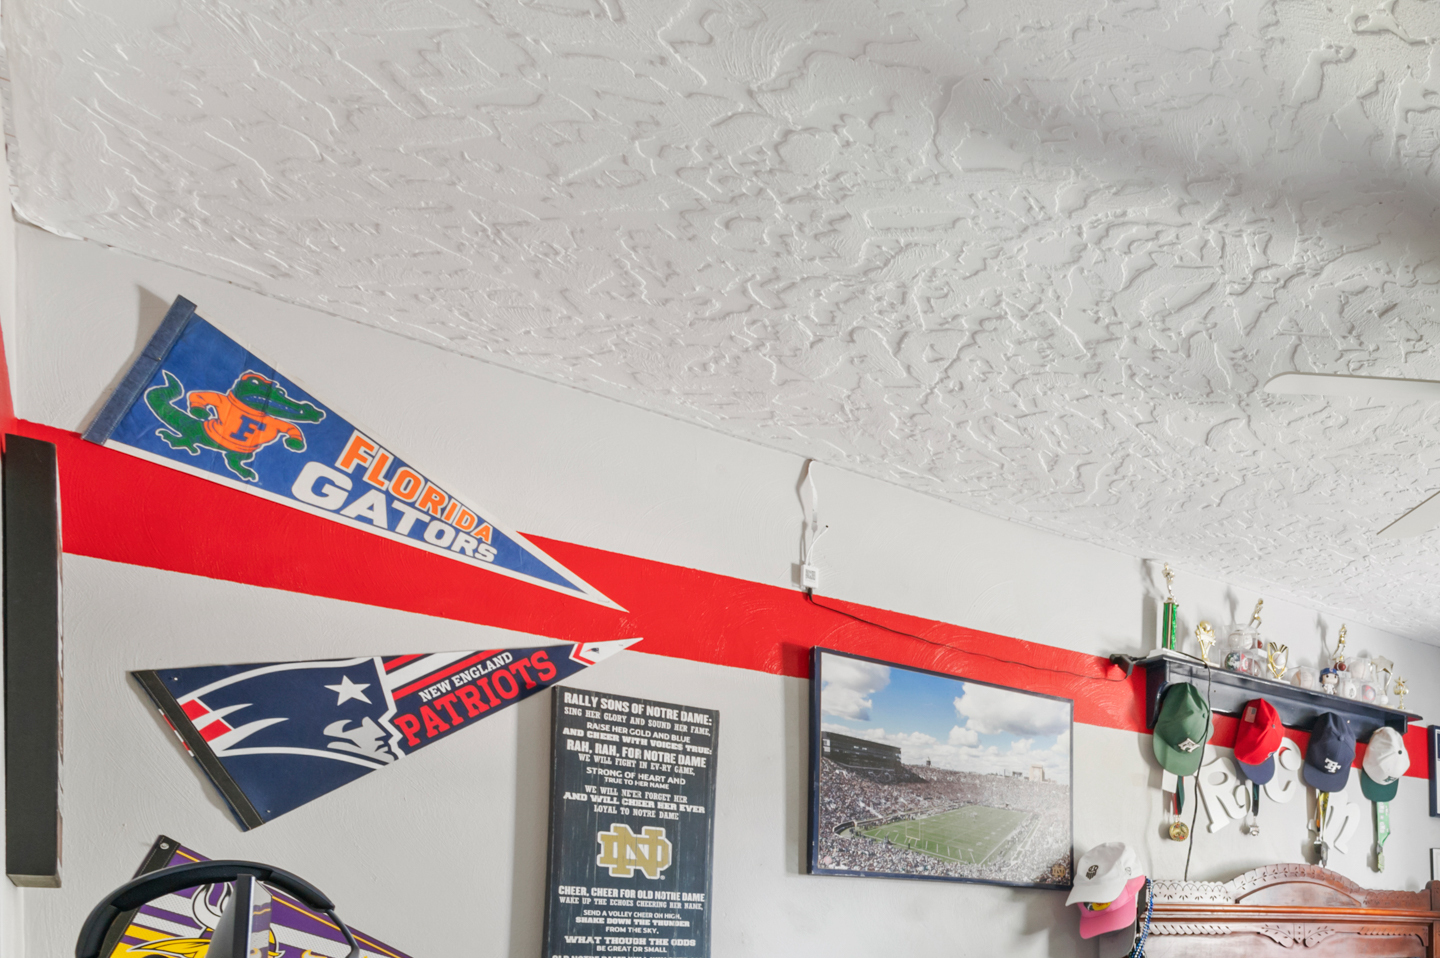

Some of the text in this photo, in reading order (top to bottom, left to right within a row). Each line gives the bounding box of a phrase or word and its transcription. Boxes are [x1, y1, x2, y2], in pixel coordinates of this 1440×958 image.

[230, 415, 266, 442] F
[335, 429, 494, 545] FLORIDA
[291, 461, 498, 563] GATORS
[418, 651, 513, 703] NEW ENGLAND
[394, 650, 557, 748] PATRIOTS
[564, 692, 712, 726] RALLY SONS OF NOTRE DAME:
[564, 707, 711, 737] SING HER GLORY AND SOUND HER FAME,
[587, 722, 691, 743] RAISE HER GOLD AND BLUE
[563, 728, 712, 755] AND CHEER WITH VOICES TRUE:
[567, 739, 707, 768] RAH, RAH, FOR NOTRE DAME
[579, 753, 591, 762] WE
[594, 755, 612, 765] WILL
[615, 758, 636, 768] FIGHT
[639, 761, 648, 769] IN
[675, 766, 695, 776] GAME,
[587, 767, 623, 778] STRONG
[638, 774, 666, 783] HEART
[604, 777, 623, 785] TRUE
[1198, 752, 1249, 833] R
[563, 792, 706, 814] AND WILL CHEER HER EVER
[585, 785, 598, 793] WE
[601, 787, 619, 796] WILL
[645, 792, 671, 802] FORGET
[674, 795, 688, 803] HER
[594, 805, 680, 821] LOYAL TO NOTRE DAME
[560, 896, 580, 904] WAKE
[594, 898, 607, 906] THE
[610, 899, 634, 907] ECHOES
[637, 900, 667, 909] CHEERING
[591, 887, 619, 898] CHEER
[620, 889, 636, 899] FOR
[637, 890, 653, 900] OLD
[655, 891, 681, 901] NOTRE
[682, 892, 705, 902] DAME
[564, 936, 696, 947] WHAT THOUGH THE ODDS
